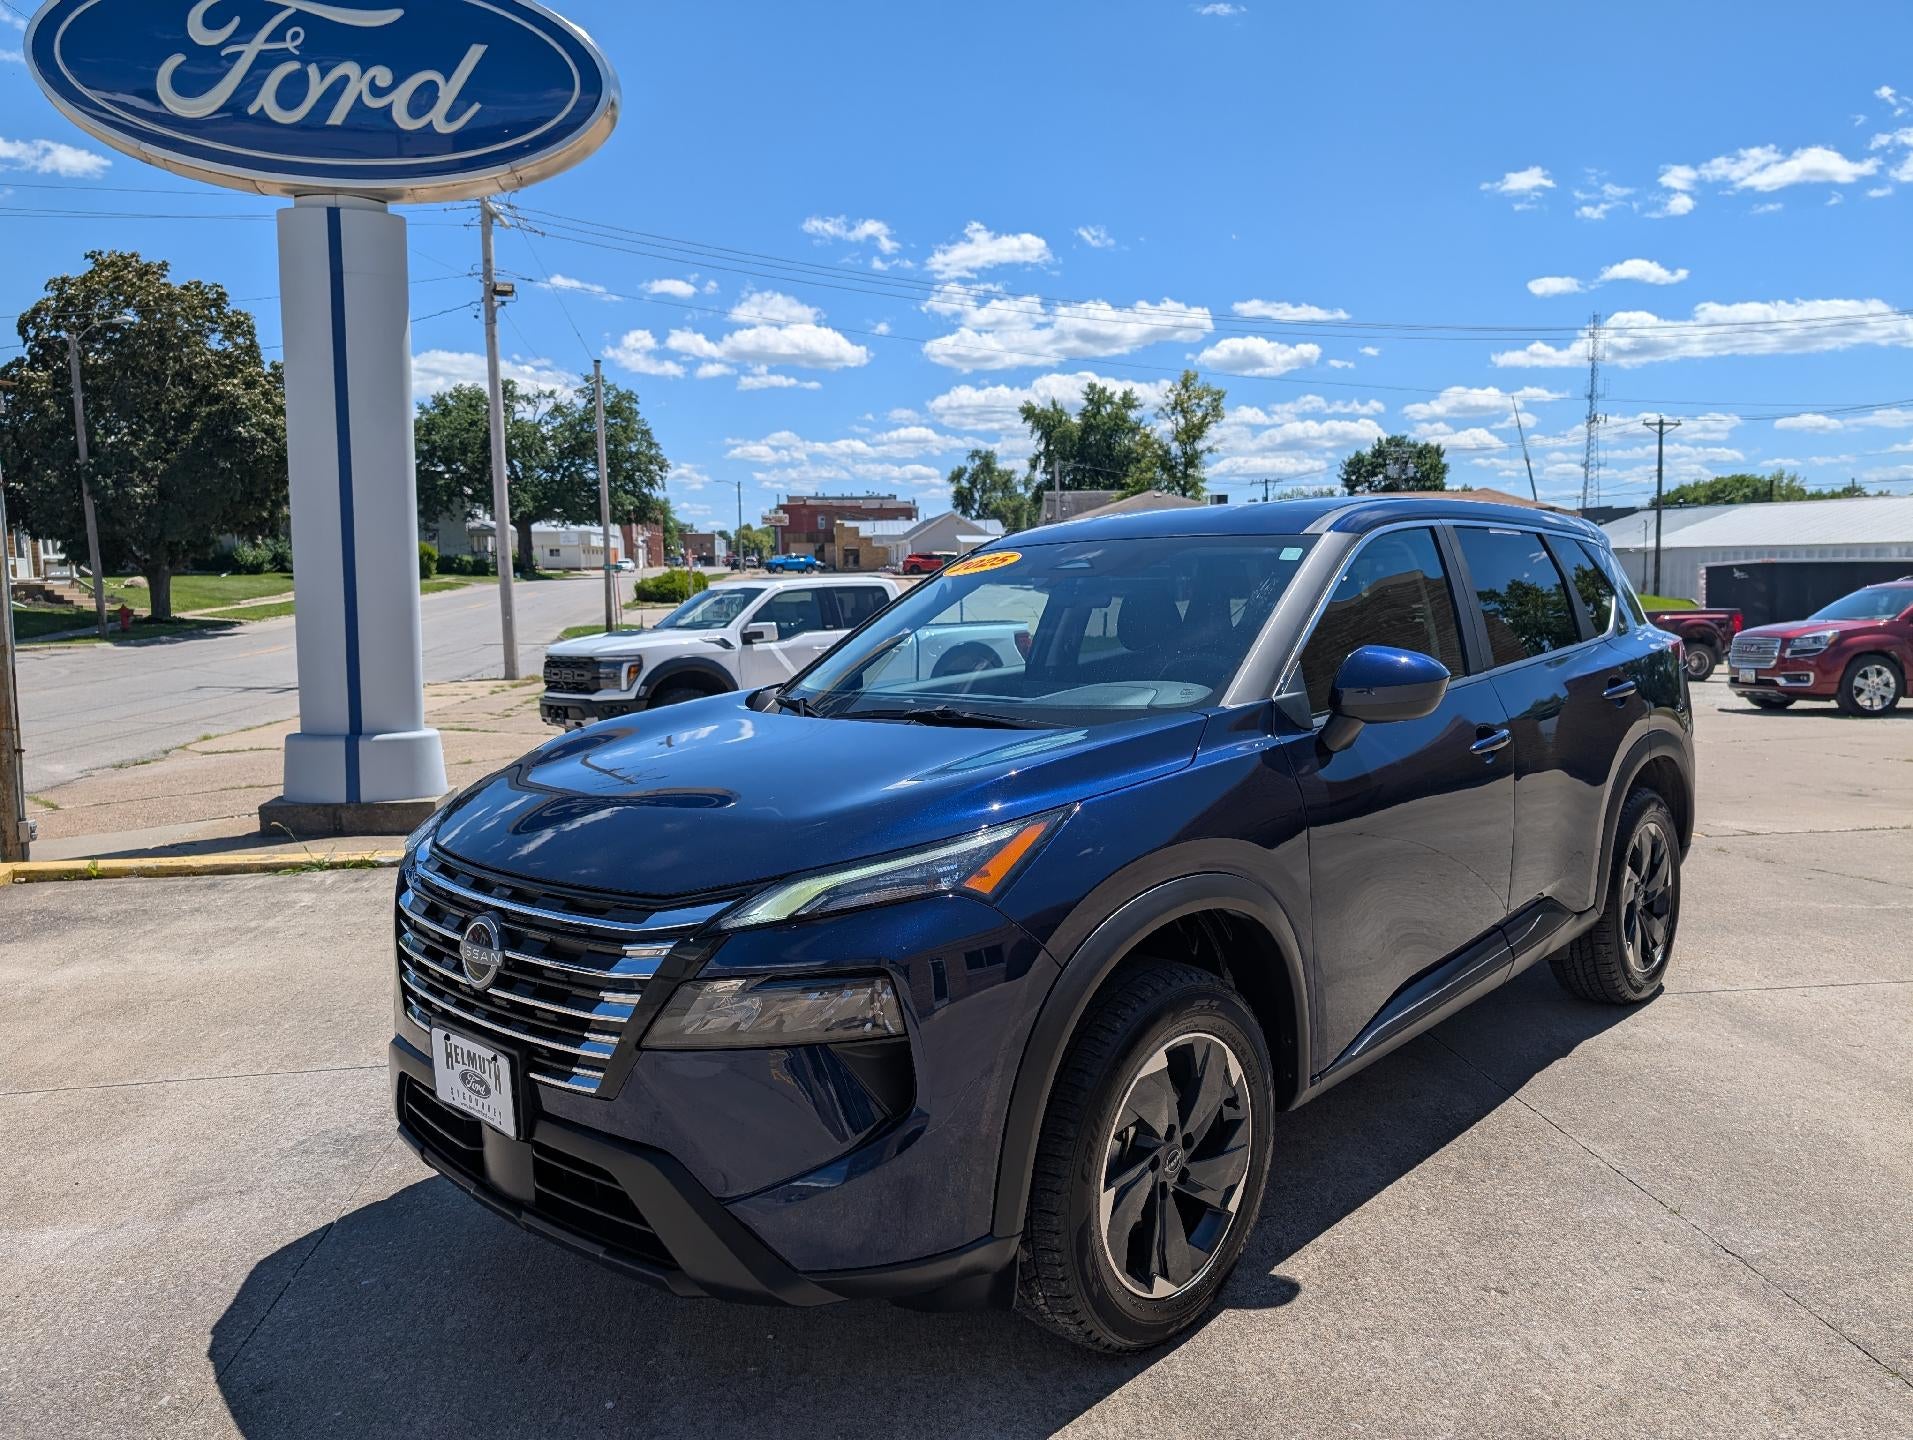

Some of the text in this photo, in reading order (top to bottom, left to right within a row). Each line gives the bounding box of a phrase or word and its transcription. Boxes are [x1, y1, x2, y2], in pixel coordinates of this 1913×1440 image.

[156, 0, 489, 134] Ford
[462, 944, 501, 963] SSAN
[444, 1041, 502, 1095] HELMUTH
[465, 1073, 486, 1096] Ford
